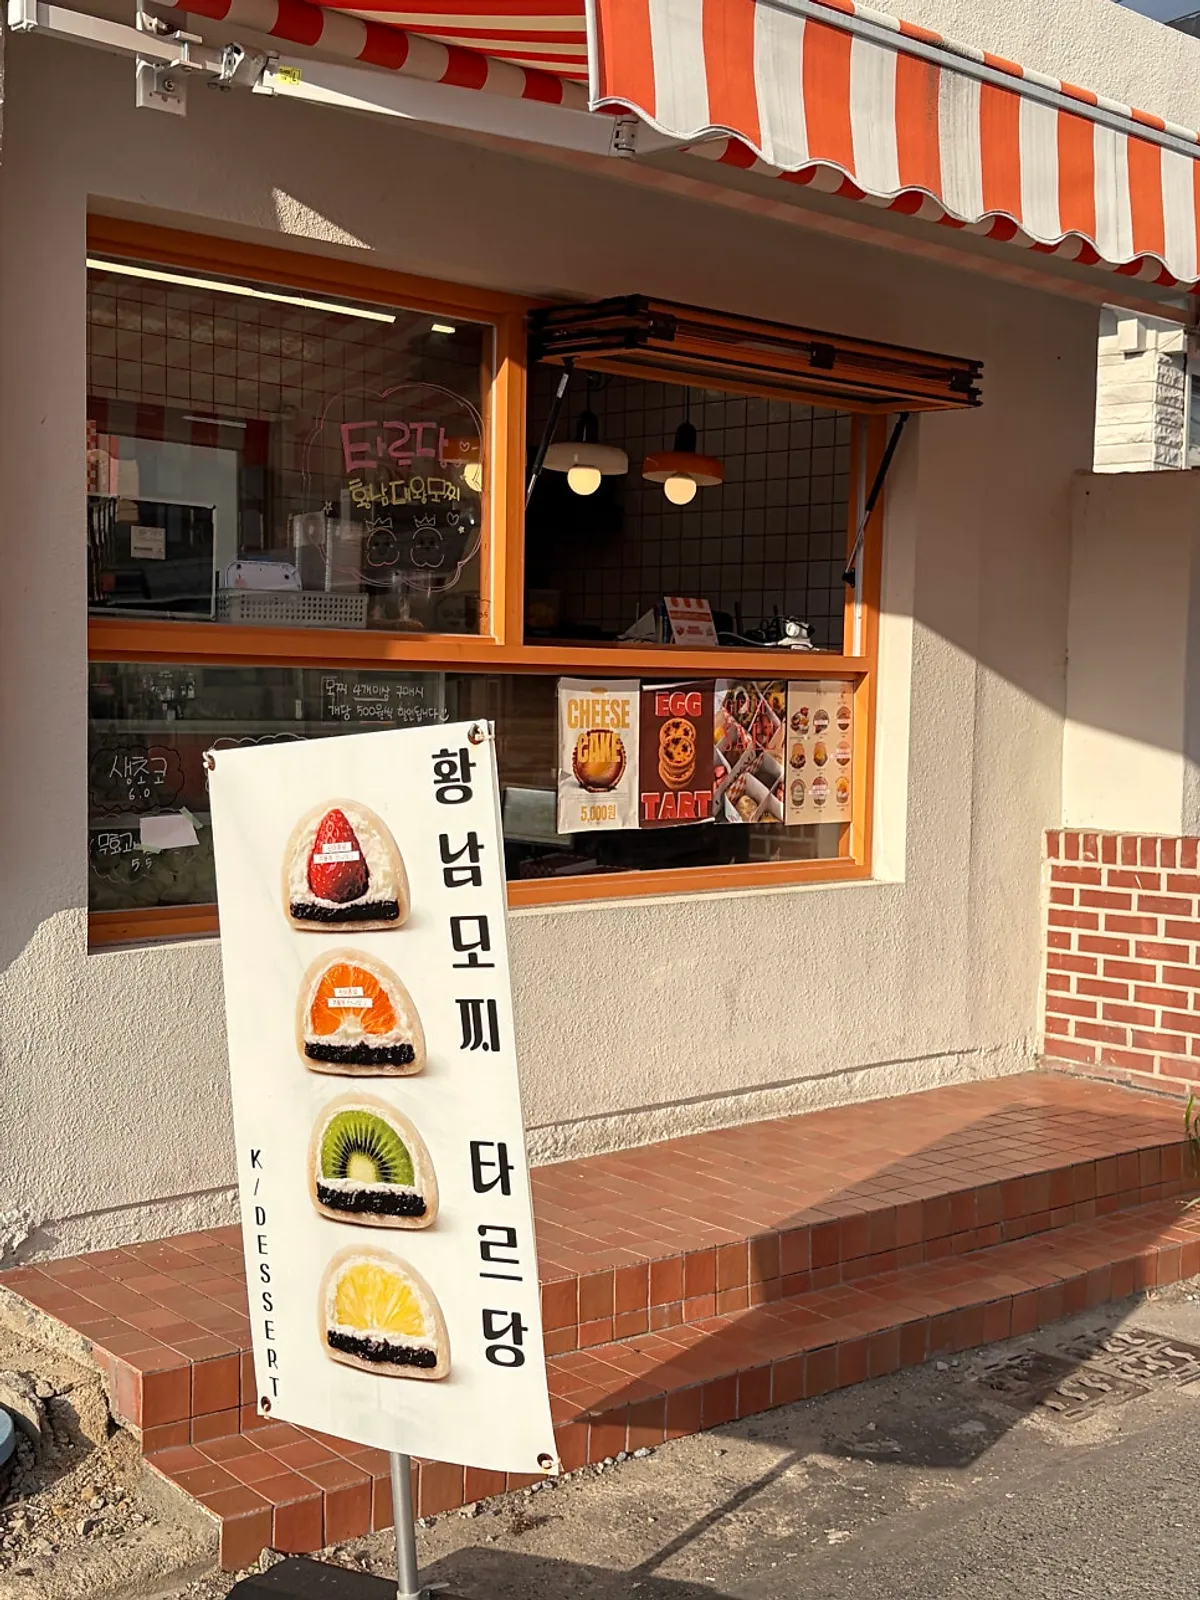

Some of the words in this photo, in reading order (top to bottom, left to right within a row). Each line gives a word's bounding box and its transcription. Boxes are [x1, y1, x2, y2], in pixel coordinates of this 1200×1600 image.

[567, 698, 631, 730] CHEESE
[655, 690, 702, 717] EGG
[576, 733, 621, 764] CAKE
[108, 755, 168, 785] 생초코
[128, 787, 151, 800] 6.0
[641, 790, 713, 821] TART
[580, 804, 617, 822] 5,000원
[469, 1139, 529, 1368] 타르당
